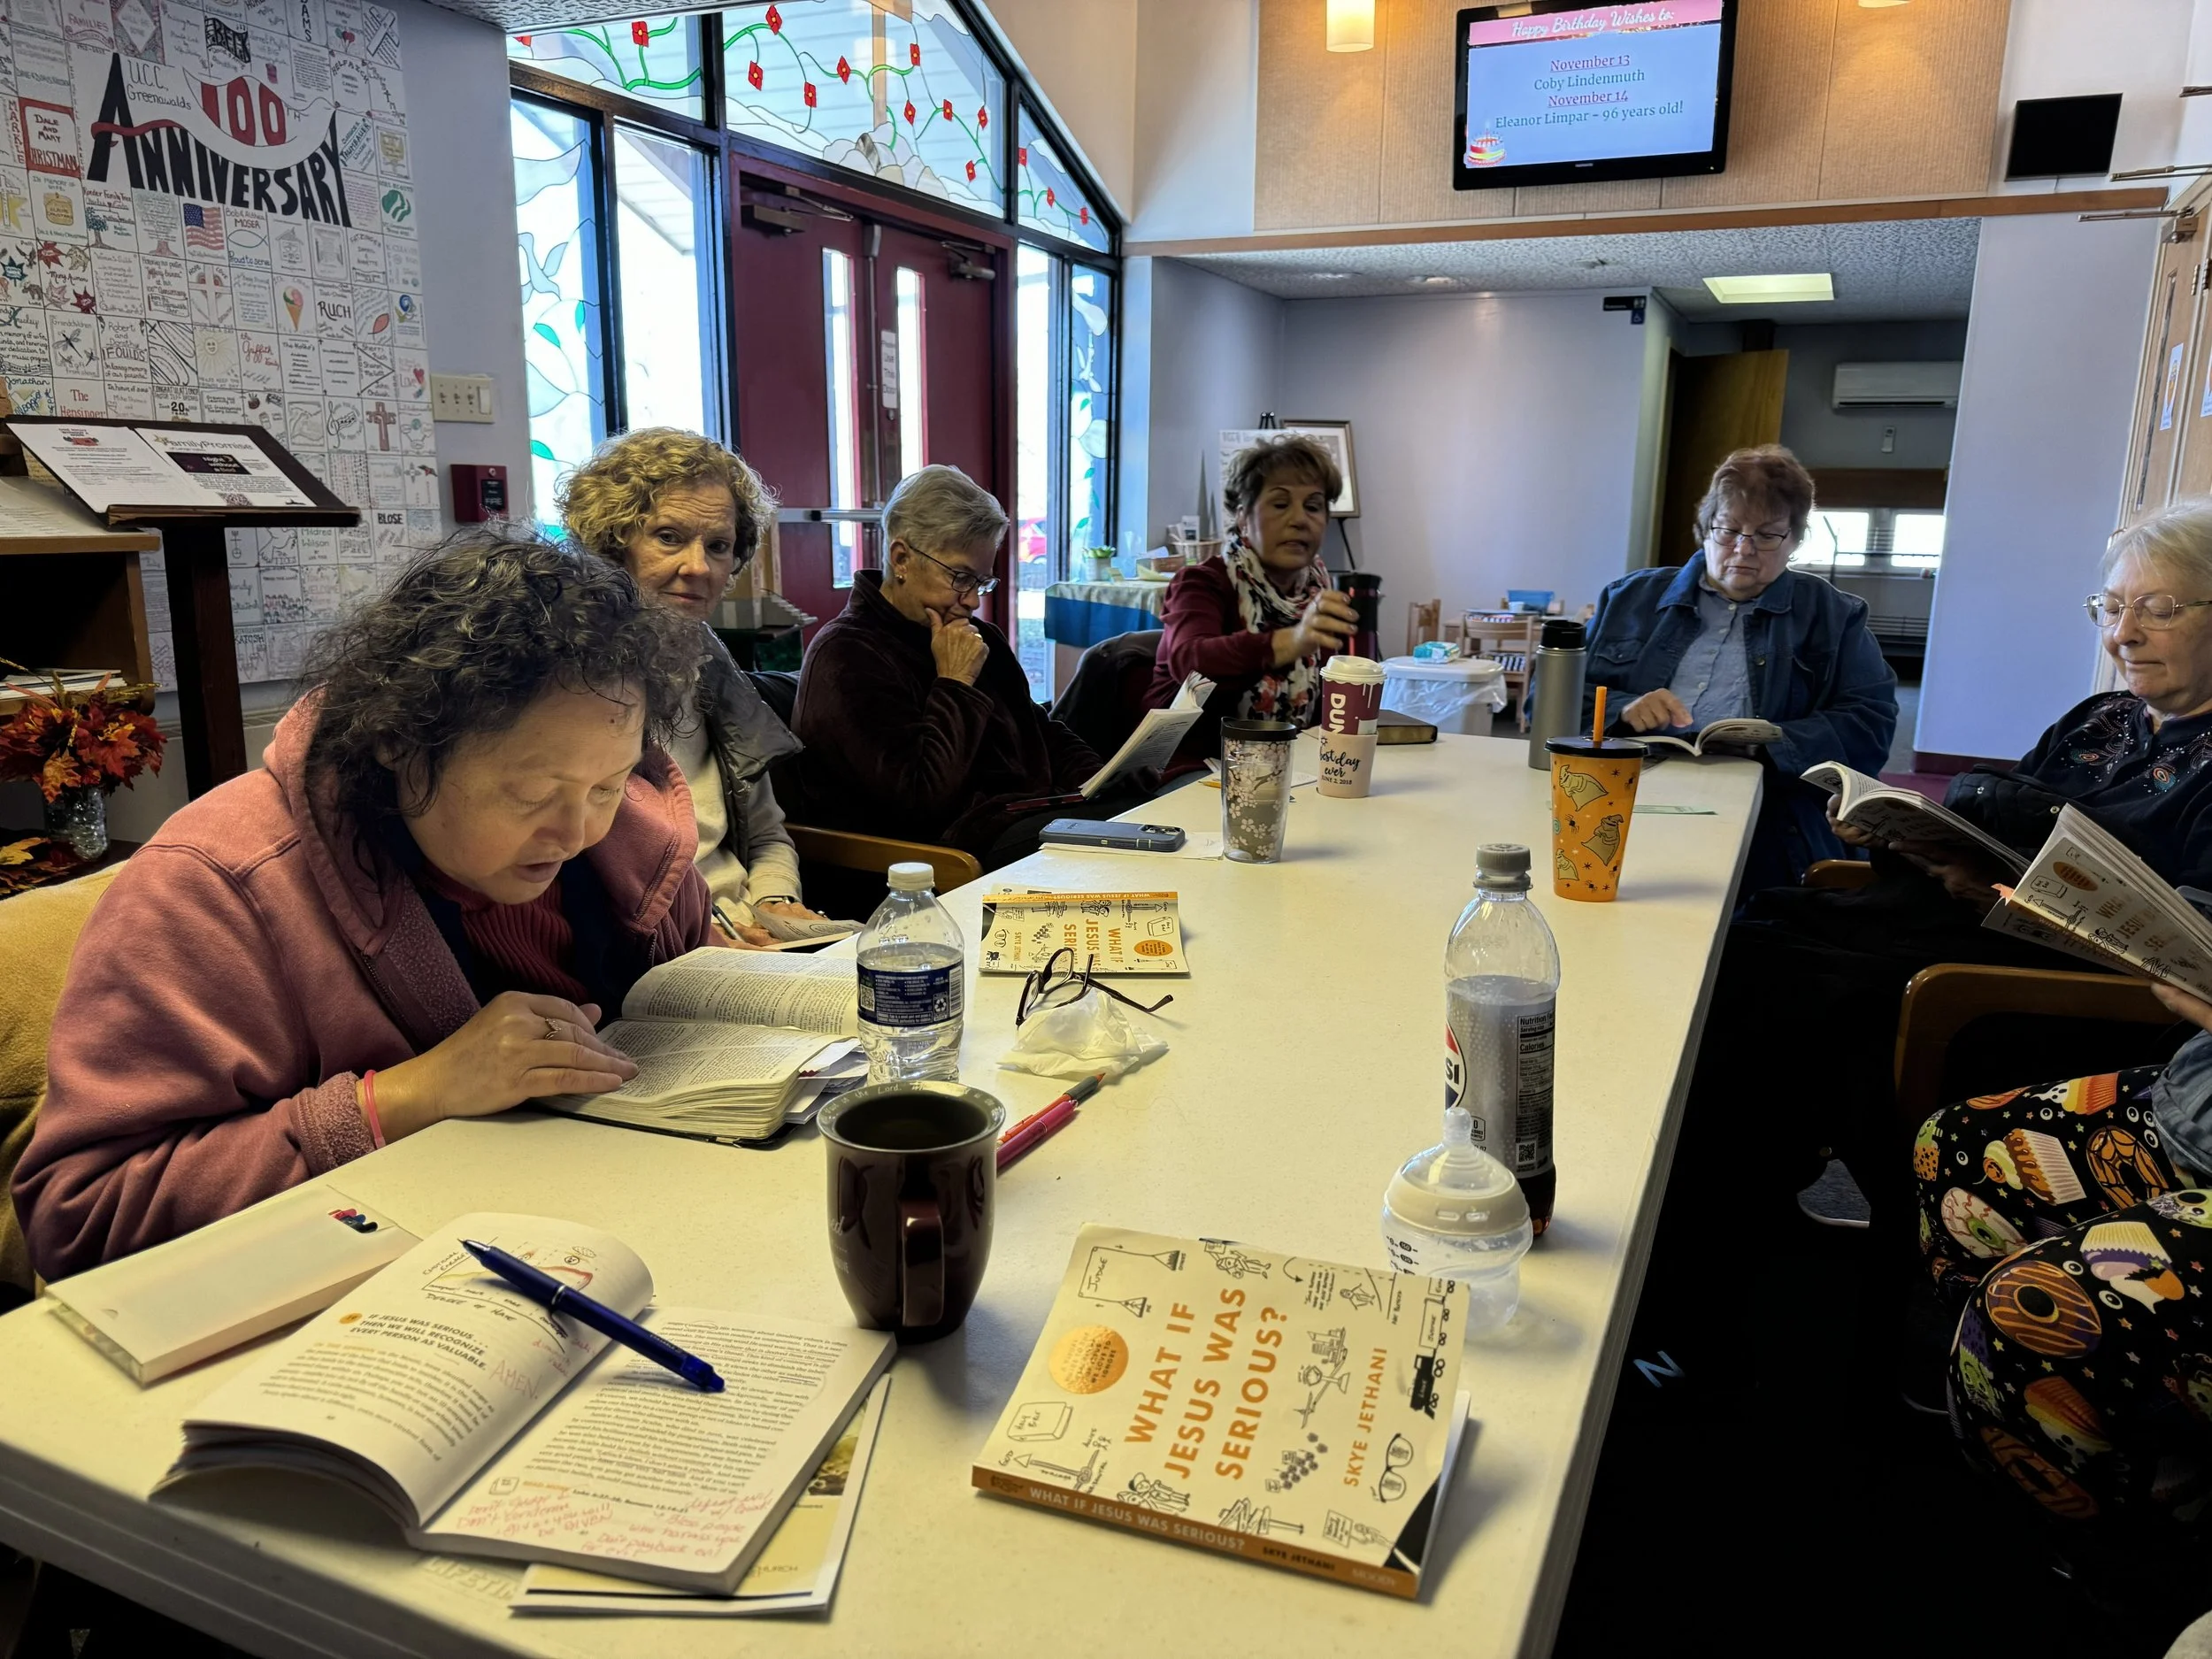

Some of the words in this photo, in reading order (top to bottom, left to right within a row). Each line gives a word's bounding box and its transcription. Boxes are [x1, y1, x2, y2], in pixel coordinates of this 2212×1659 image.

[68, 13, 110, 31] FAMILIES
[1512, 20, 1549, 38] Happy
[1552, 13, 1608, 34] Birthday
[1611, 8, 1656, 27] Wishes
[1658, 9, 1675, 21] to:
[1550, 57, 1615, 72] November
[1617, 55, 1631, 67] 13
[1533, 78, 1565, 92] Coby
[1567, 69, 1646, 88] Lindenmuth
[126, 84, 193, 111] Greenawalds
[1548, 92, 1612, 107] November
[1614, 90, 1629, 103] 14
[201, 76, 287, 146] 100
[1495, 116, 1541, 128] Eleanor
[1544, 111, 1590, 126] Limpar
[1602, 109, 1618, 121] 96
[1621, 105, 1656, 122] years
[1658, 100, 1684, 115] old!
[8, 100, 26, 165] MARKLE
[87, 52, 351, 228] ANNIVERSARY
[234, 219, 261, 229] MOSER
[228, 250, 252, 264] Proud
[317, 300, 351, 321] RUCH
[108, 321, 134, 333] Robert
[5, 375, 50, 390] Jonathan
[71, 388, 89, 403] The
[171, 401, 185, 411] 20
[377, 513, 403, 525] BLOSE
[1329, 693, 1347, 734] DUN
[1324, 764, 1347, 779] ever
[1334, 751, 1362, 772] day
[1086, 918, 1100, 951] JESUS
[1108, 927, 1122, 954] WHAT
[1520, 1015, 1548, 1026] Nutrition
[1519, 1041, 1545, 1052] Calories
[855, 1087, 870, 1099] the
[878, 1083, 902, 1095] Lord.
[1087, 1256, 1109, 1293] JUDGE
[380, 1314, 407, 1324] JESUS
[409, 1317, 431, 1328] WAS
[350, 1327, 380, 1337] EVERY
[381, 1330, 419, 1344] PERSON
[436, 1341, 487, 1372] VALUABLE.
[359, 1320, 387, 1330] THEN
[402, 1325, 427, 1336] WILL
[428, 1329, 486, 1357] RECOGNIZE
[1095, 1352, 1107, 1371] LOVE
[1102, 1348, 1117, 1379] IGNORE
[1125, 1347, 1183, 1444] WHAT
[1165, 1302, 1196, 1336] IF
[1164, 1378, 1221, 1479] JESUS
[1202, 1287, 1247, 1363] WAS
[1215, 1306, 1289, 1479] SERIOUS?
[1343, 1440, 1368, 1487] SKYE
[1357, 1347, 1387, 1434] JETHANI
[1030, 1486, 1070, 1508] WHAT
[1074, 1496, 1087, 1509] IF
[1091, 1502, 1133, 1523] JESUS
[1137, 1514, 1168, 1532] WAS
[1173, 1523, 1246, 1551] SERIOUS?
[1263, 1547, 1287, 1561] SKYE
[1290, 1551, 1336, 1571] JETHANI
